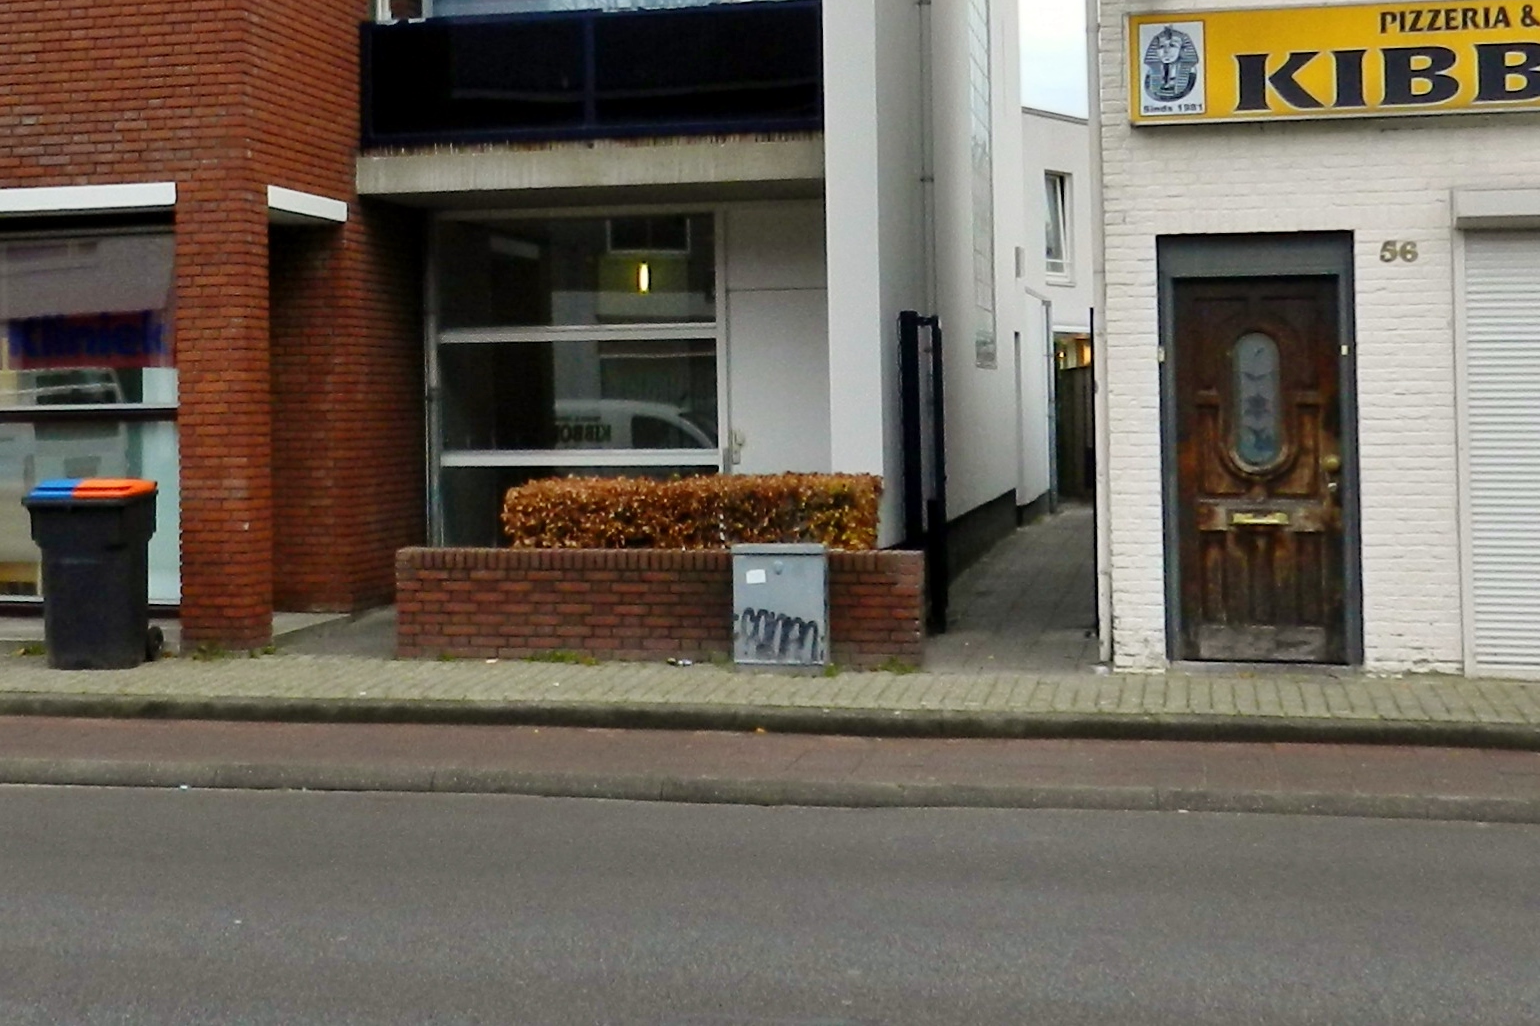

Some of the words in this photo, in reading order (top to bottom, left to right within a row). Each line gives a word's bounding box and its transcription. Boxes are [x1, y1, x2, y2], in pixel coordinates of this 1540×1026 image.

[1379, 6, 1511, 34] PIZZERIA
[1520, 4, 1540, 27] &
[1233, 42, 1540, 112] KIBB
[1380, 240, 1419, 263] 56
